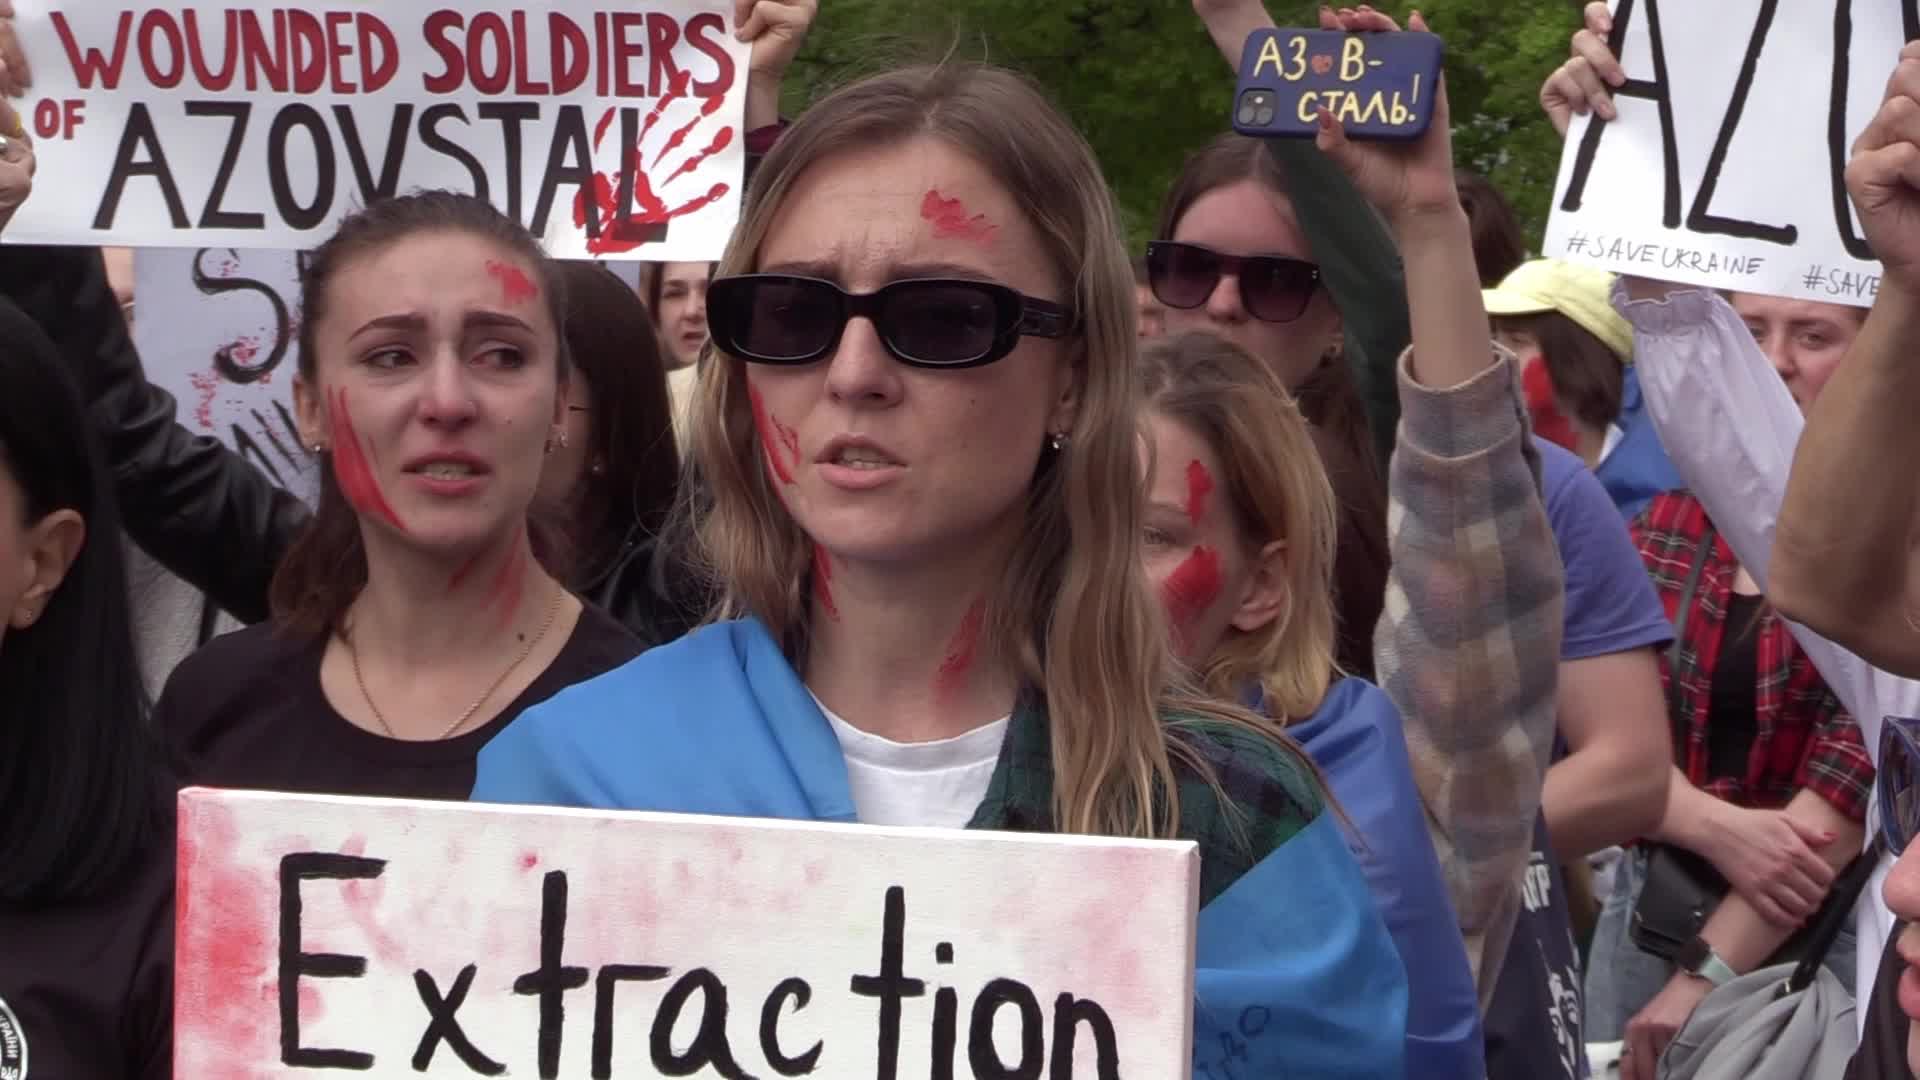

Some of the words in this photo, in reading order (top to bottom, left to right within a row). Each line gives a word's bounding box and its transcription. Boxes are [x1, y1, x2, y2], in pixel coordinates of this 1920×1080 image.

[51, 8, 400, 95] WOUNDED
[422, 10, 736, 98] SOLDIERS
[33, 99, 85, 141] OF
[1297, 73, 1421, 125] СТАЛЬ!
[90, 100, 670, 244] AZOVSTAL
[1566, 231, 1765, 275] #SAVEUKRAINE
[278, 851, 1119, 1080] Extraction
